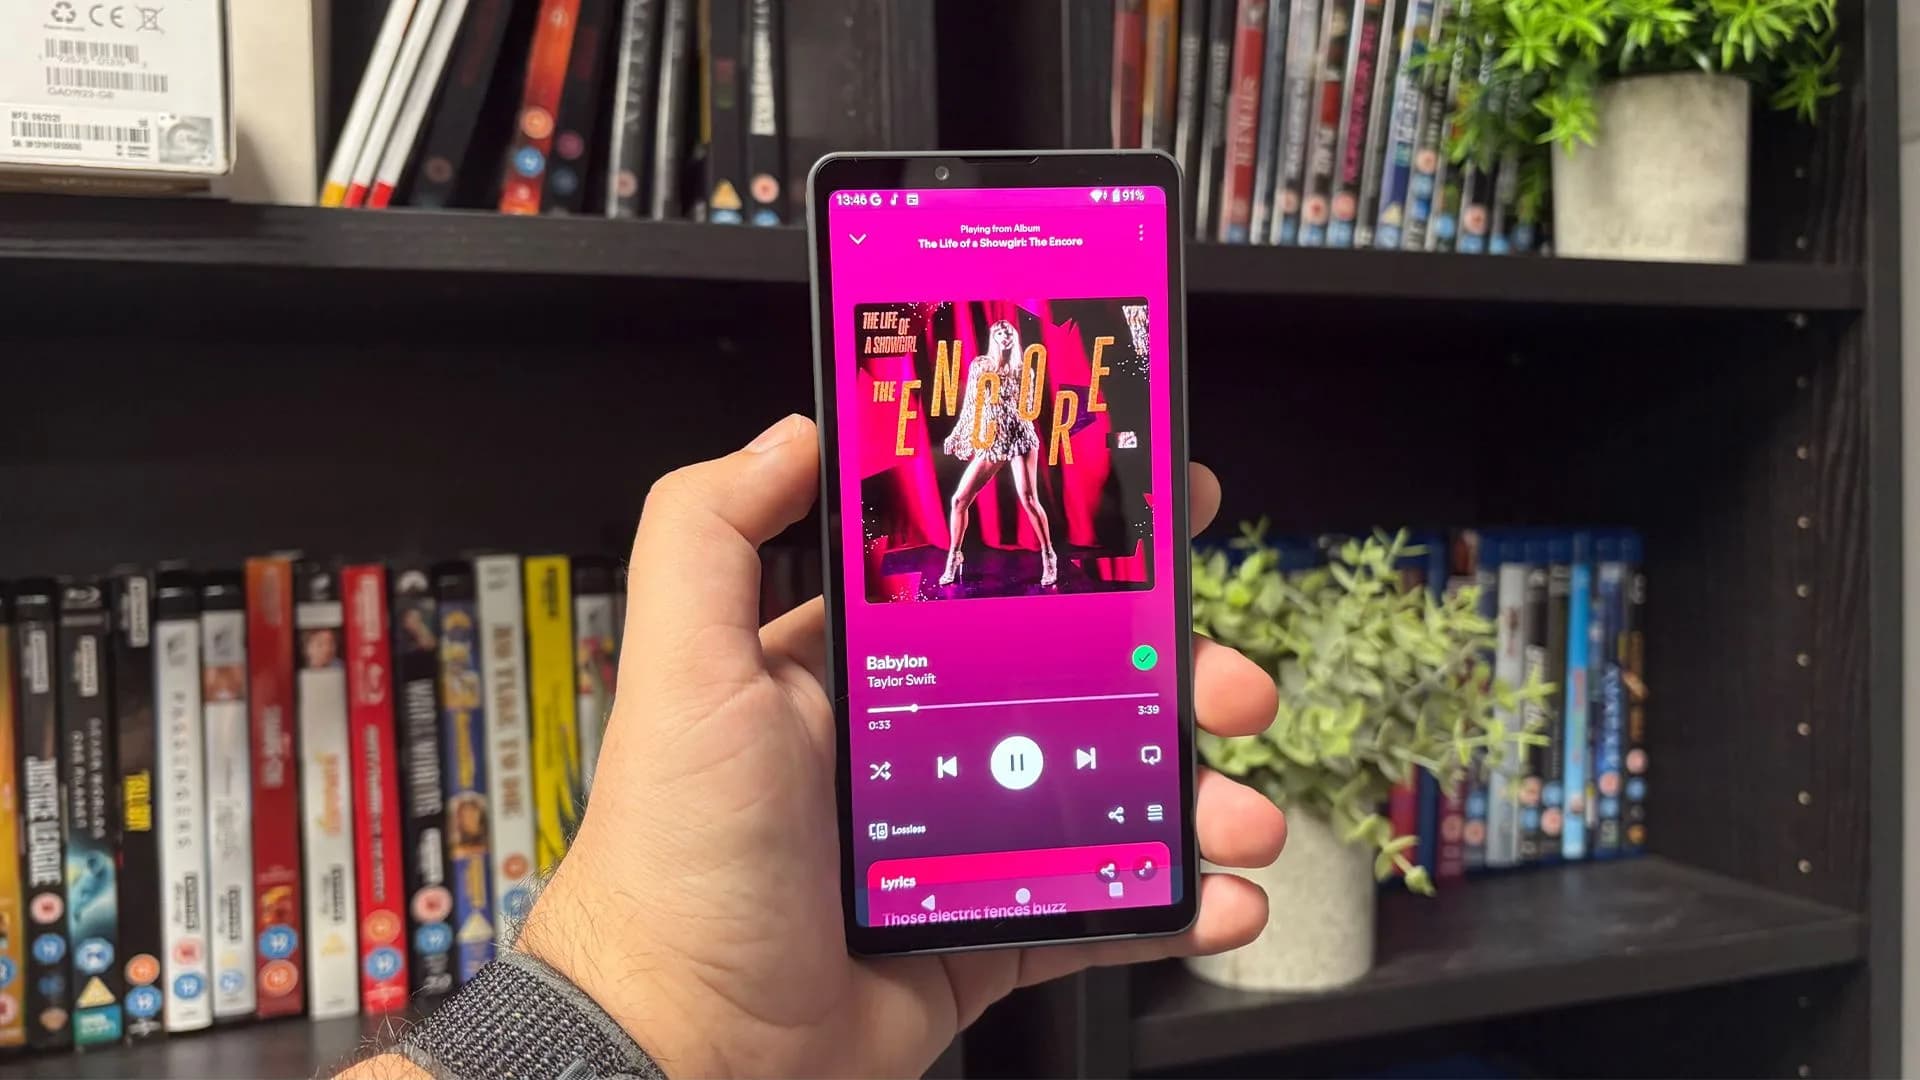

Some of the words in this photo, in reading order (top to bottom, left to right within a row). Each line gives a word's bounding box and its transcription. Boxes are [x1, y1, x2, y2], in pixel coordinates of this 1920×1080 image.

[836, 193, 867, 206] 13:46
[1122, 190, 1144, 202] 91%
[960, 224, 991, 235] Playing
[991, 224, 1012, 233] from
[1013, 223, 1040, 233] Album
[918, 239, 937, 248] The
[939, 238, 958, 248] Life
[959, 238, 972, 248] of
[972, 240, 978, 248] a
[979, 238, 1027, 249] Showgirl:
[1028, 237, 1047, 247] The
[1049, 237, 1083, 247] Encore
[863, 312, 879, 329] THE
[880, 312, 898, 329] LIFE
[898, 318, 910, 335] OF
[864, 336, 871, 354] A
[873, 335, 917, 354] SHOWGIRL
[873, 381, 896, 402] THE
[895, 336, 1115, 466] ENCORE
[867, 654, 927, 671] Babylon
[867, 676, 903, 689] Taylor
[905, 673, 936, 686] Swift
[868, 720, 891, 730] 0:33
[1138, 705, 1160, 715] 3:39
[172, 691, 194, 849] PASSENGERS
[25, 755, 59, 822] JUSTICE
[891, 824, 926, 835] Lossless
[29, 820, 61, 887] LEAGUE
[880, 876, 916, 891] Lyrics
[882, 911, 926, 926] Those
[928, 907, 982, 924] electric
[984, 905, 1030, 918] fences
[1032, 902, 1067, 915] buzz
